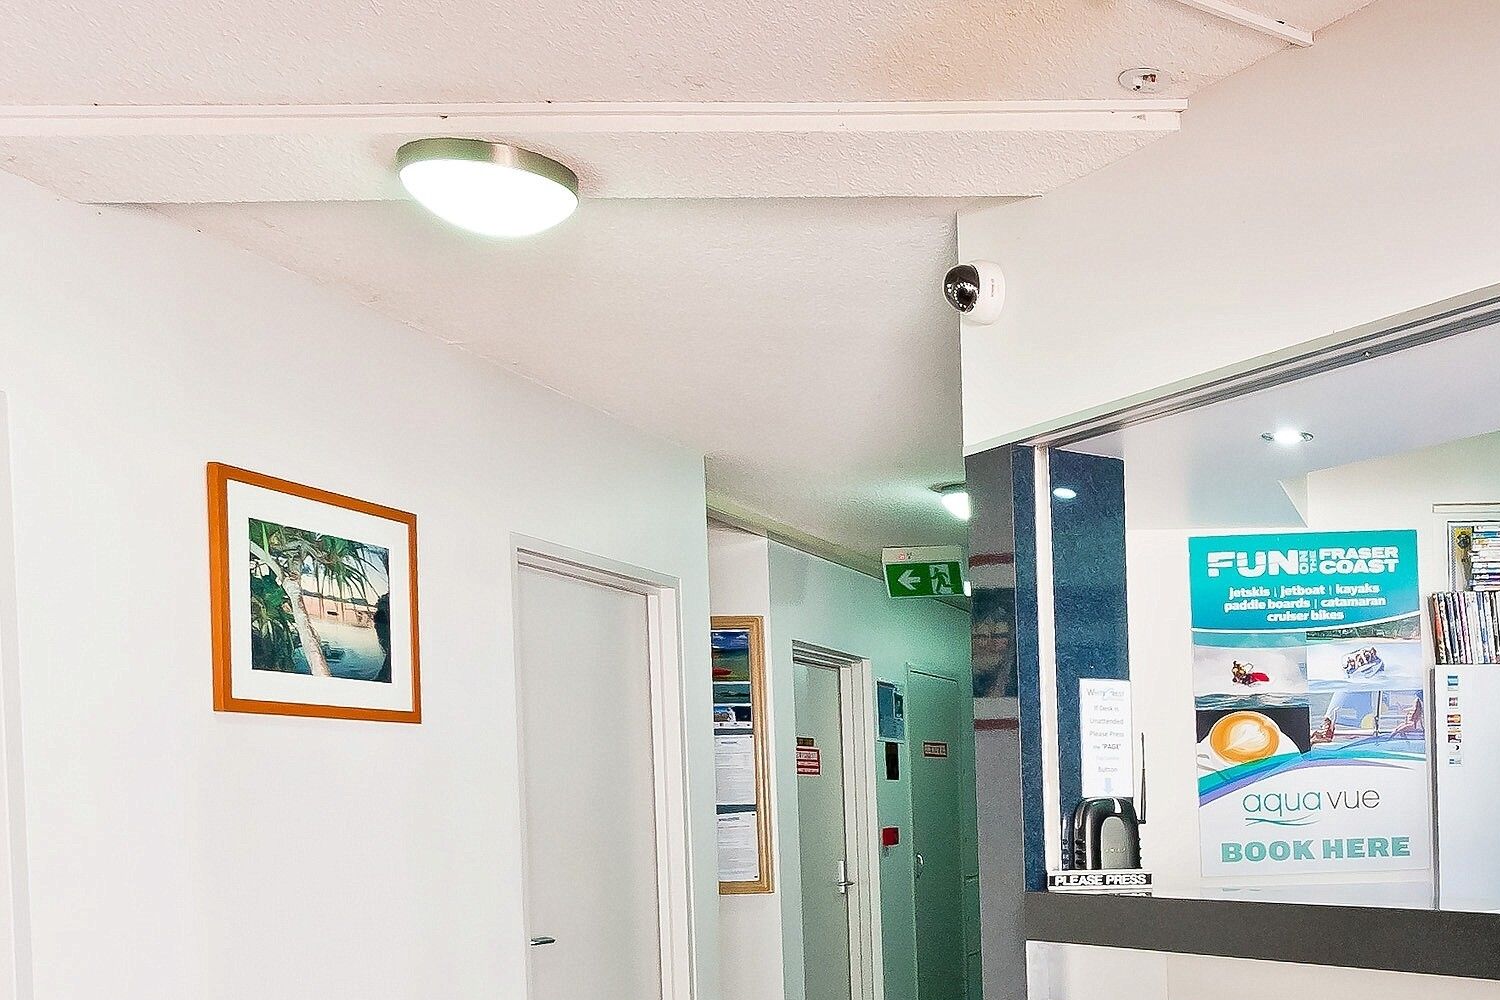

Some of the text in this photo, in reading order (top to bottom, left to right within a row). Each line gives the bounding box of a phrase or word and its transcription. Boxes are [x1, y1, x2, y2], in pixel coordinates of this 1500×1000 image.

[1319, 546, 1399, 560] FRASER
[1207, 550, 1300, 578] FUN
[1319, 558, 1399, 575] COAST
[1229, 582, 1381, 600] jetskis jetboat kayaks
[1224, 596, 1387, 613] paddle boards catamaran
[1267, 610, 1344, 622] cruiser bikes
[1242, 789, 1380, 817] aqua vue
[1221, 837, 1410, 863] BOOK HERE
[1055, 874, 1147, 887] PLEASE PRESS
